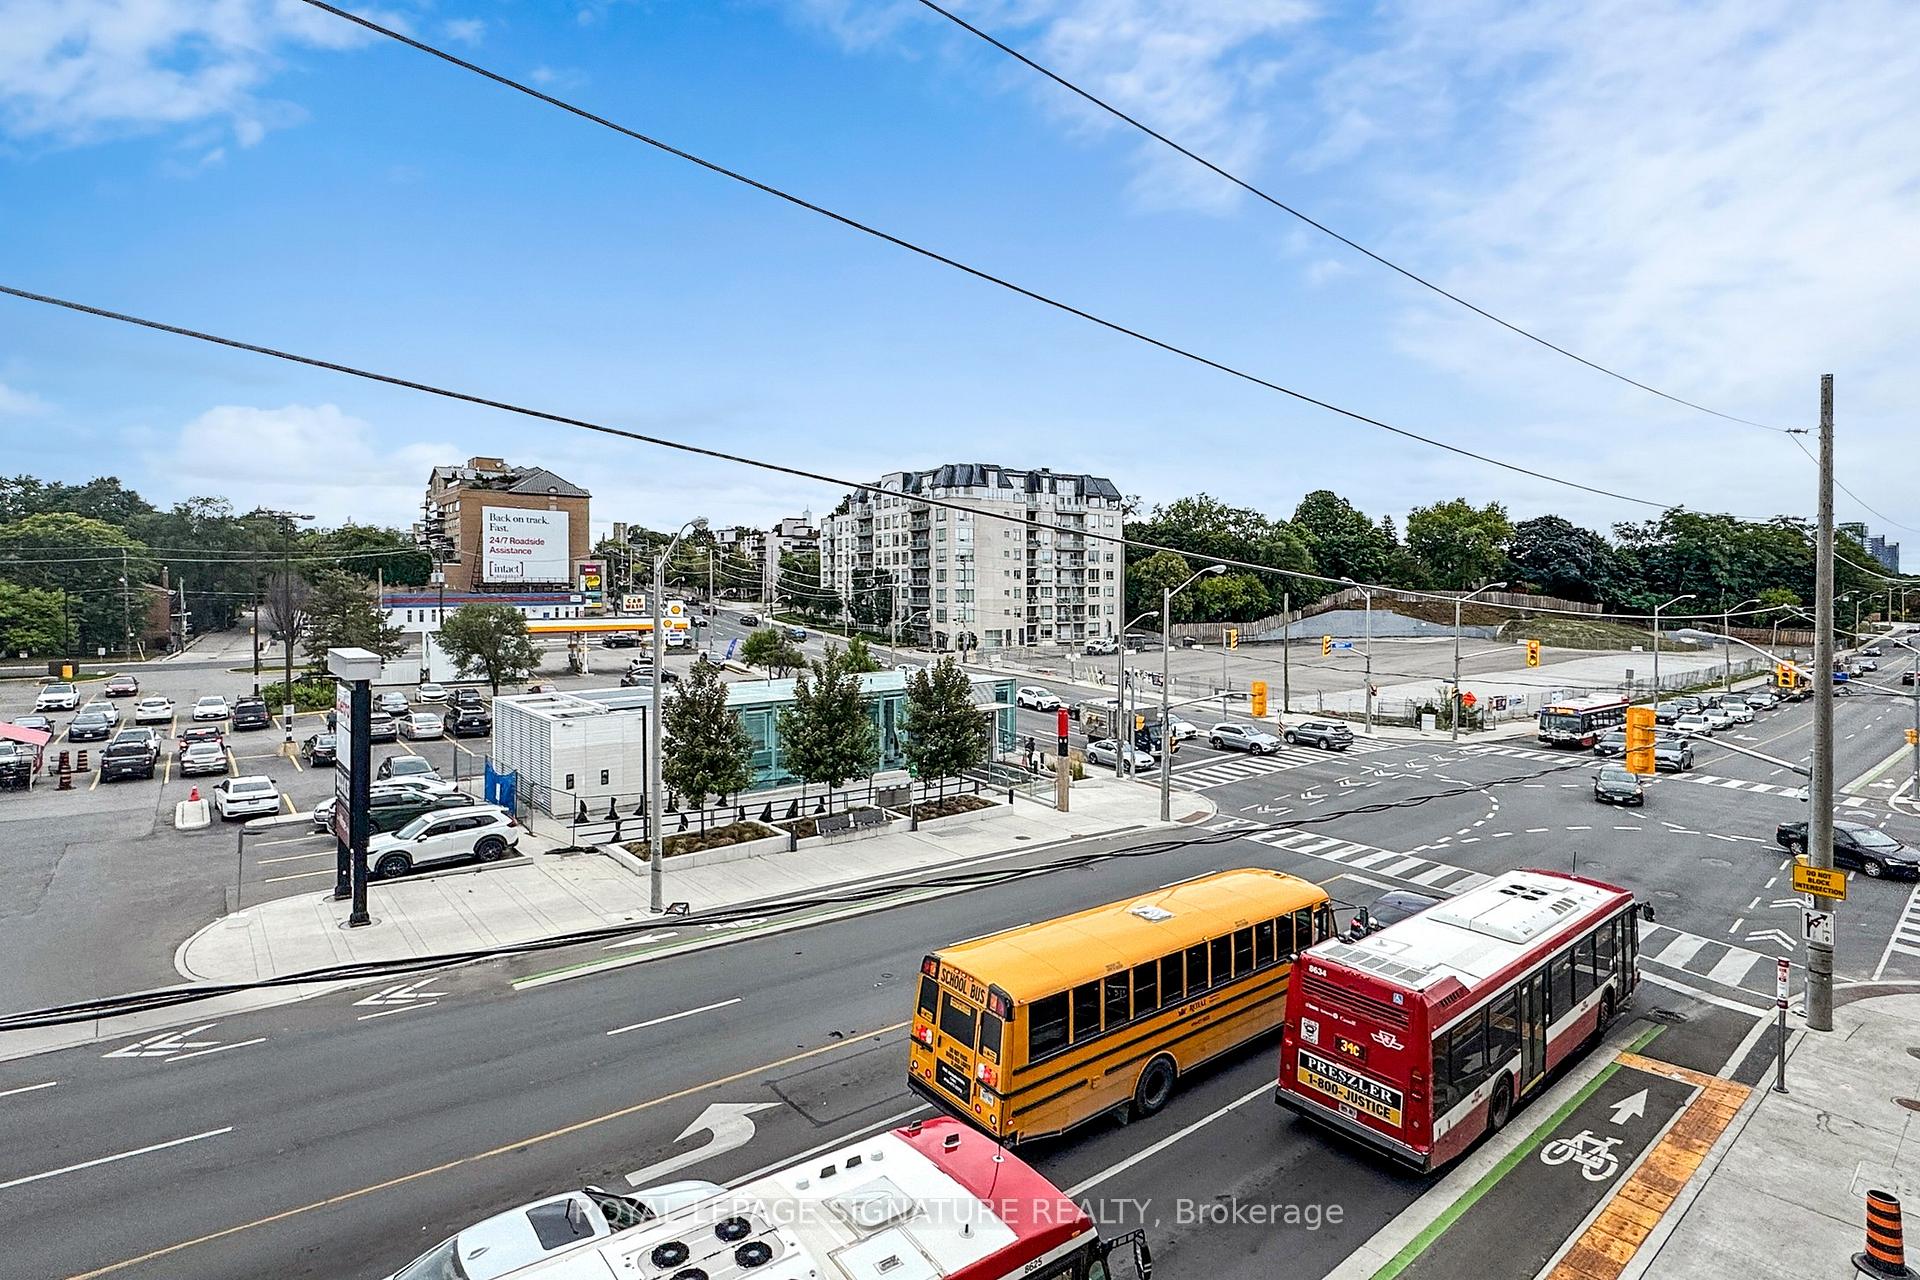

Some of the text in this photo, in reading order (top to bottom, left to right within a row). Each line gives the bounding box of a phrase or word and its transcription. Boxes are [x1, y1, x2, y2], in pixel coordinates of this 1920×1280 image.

[489, 513, 511, 522] Back
[526, 516, 550, 524] track.
[489, 523, 509, 532] Fast.
[509, 537, 545, 545] Roadside
[489, 546, 532, 554] Assistance
[1807, 877, 1830, 886] BLOCK
[1795, 882, 1843, 896] INTERSECTION
[1309, 965, 1327, 977] 8634
[941, 968, 986, 1004] SCHOOL BUS
[1340, 1040, 1360, 1056] 34C
[1308, 1057, 1392, 1103] PRESZLER
